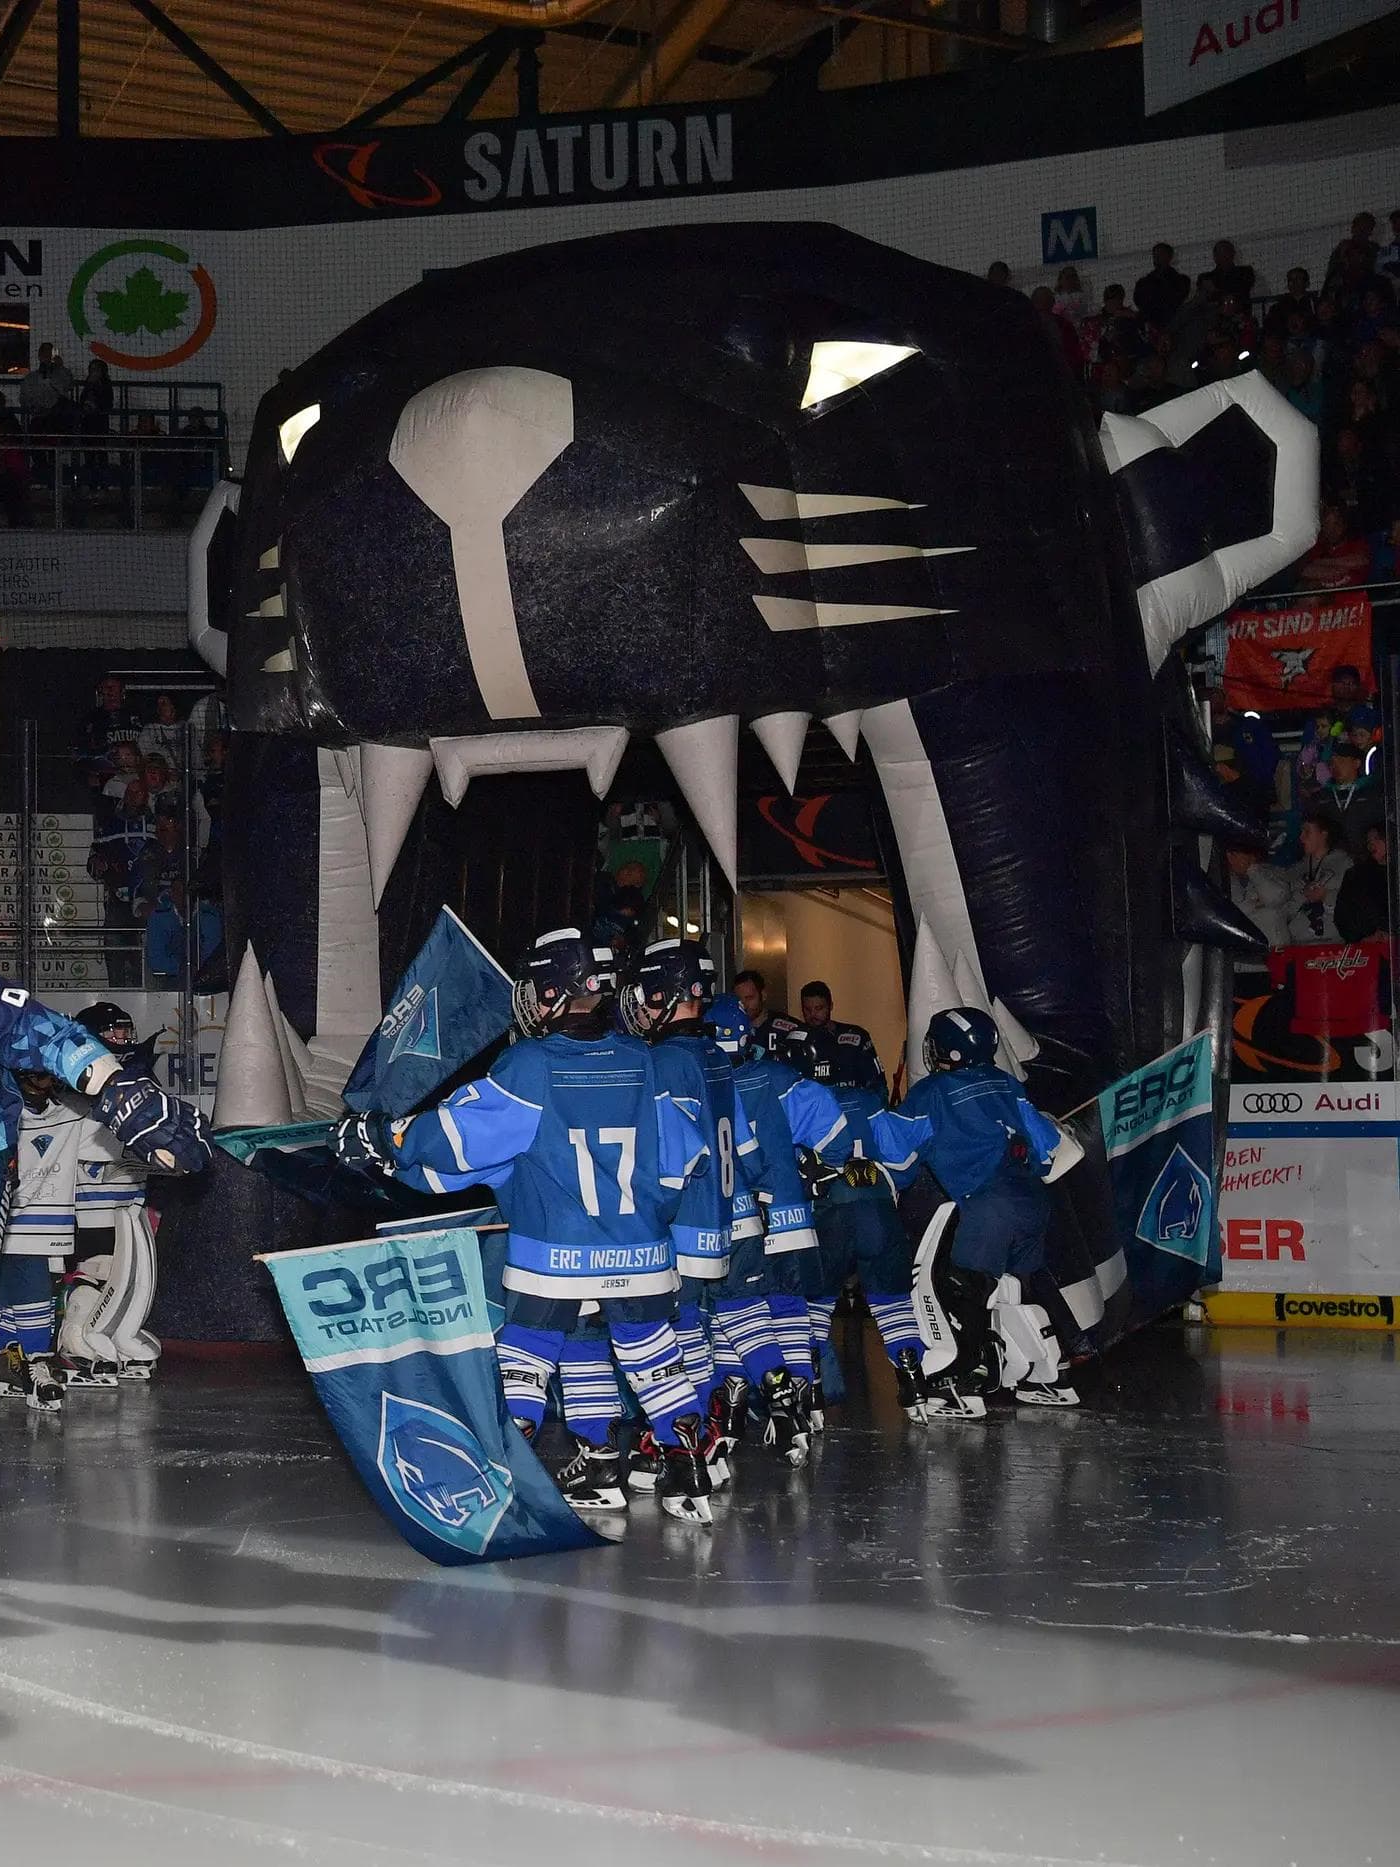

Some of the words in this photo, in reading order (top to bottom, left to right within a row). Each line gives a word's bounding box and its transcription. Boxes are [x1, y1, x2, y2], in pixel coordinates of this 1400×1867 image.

[463, 113, 734, 201] SATURN
[1046, 217, 1093, 256] M
[1263, 611, 1315, 639] SIND
[1114, 1055, 1196, 1122] ERC
[1314, 1093, 1380, 1111] Audi
[568, 1126, 637, 1217] 17
[717, 1116, 735, 1199] 8
[549, 1247, 583, 1270] ERC
[589, 1241, 669, 1270] INGOLSTADT
[922, 1294, 943, 1341] BAUER
[1285, 1299, 1381, 1318] covestro
